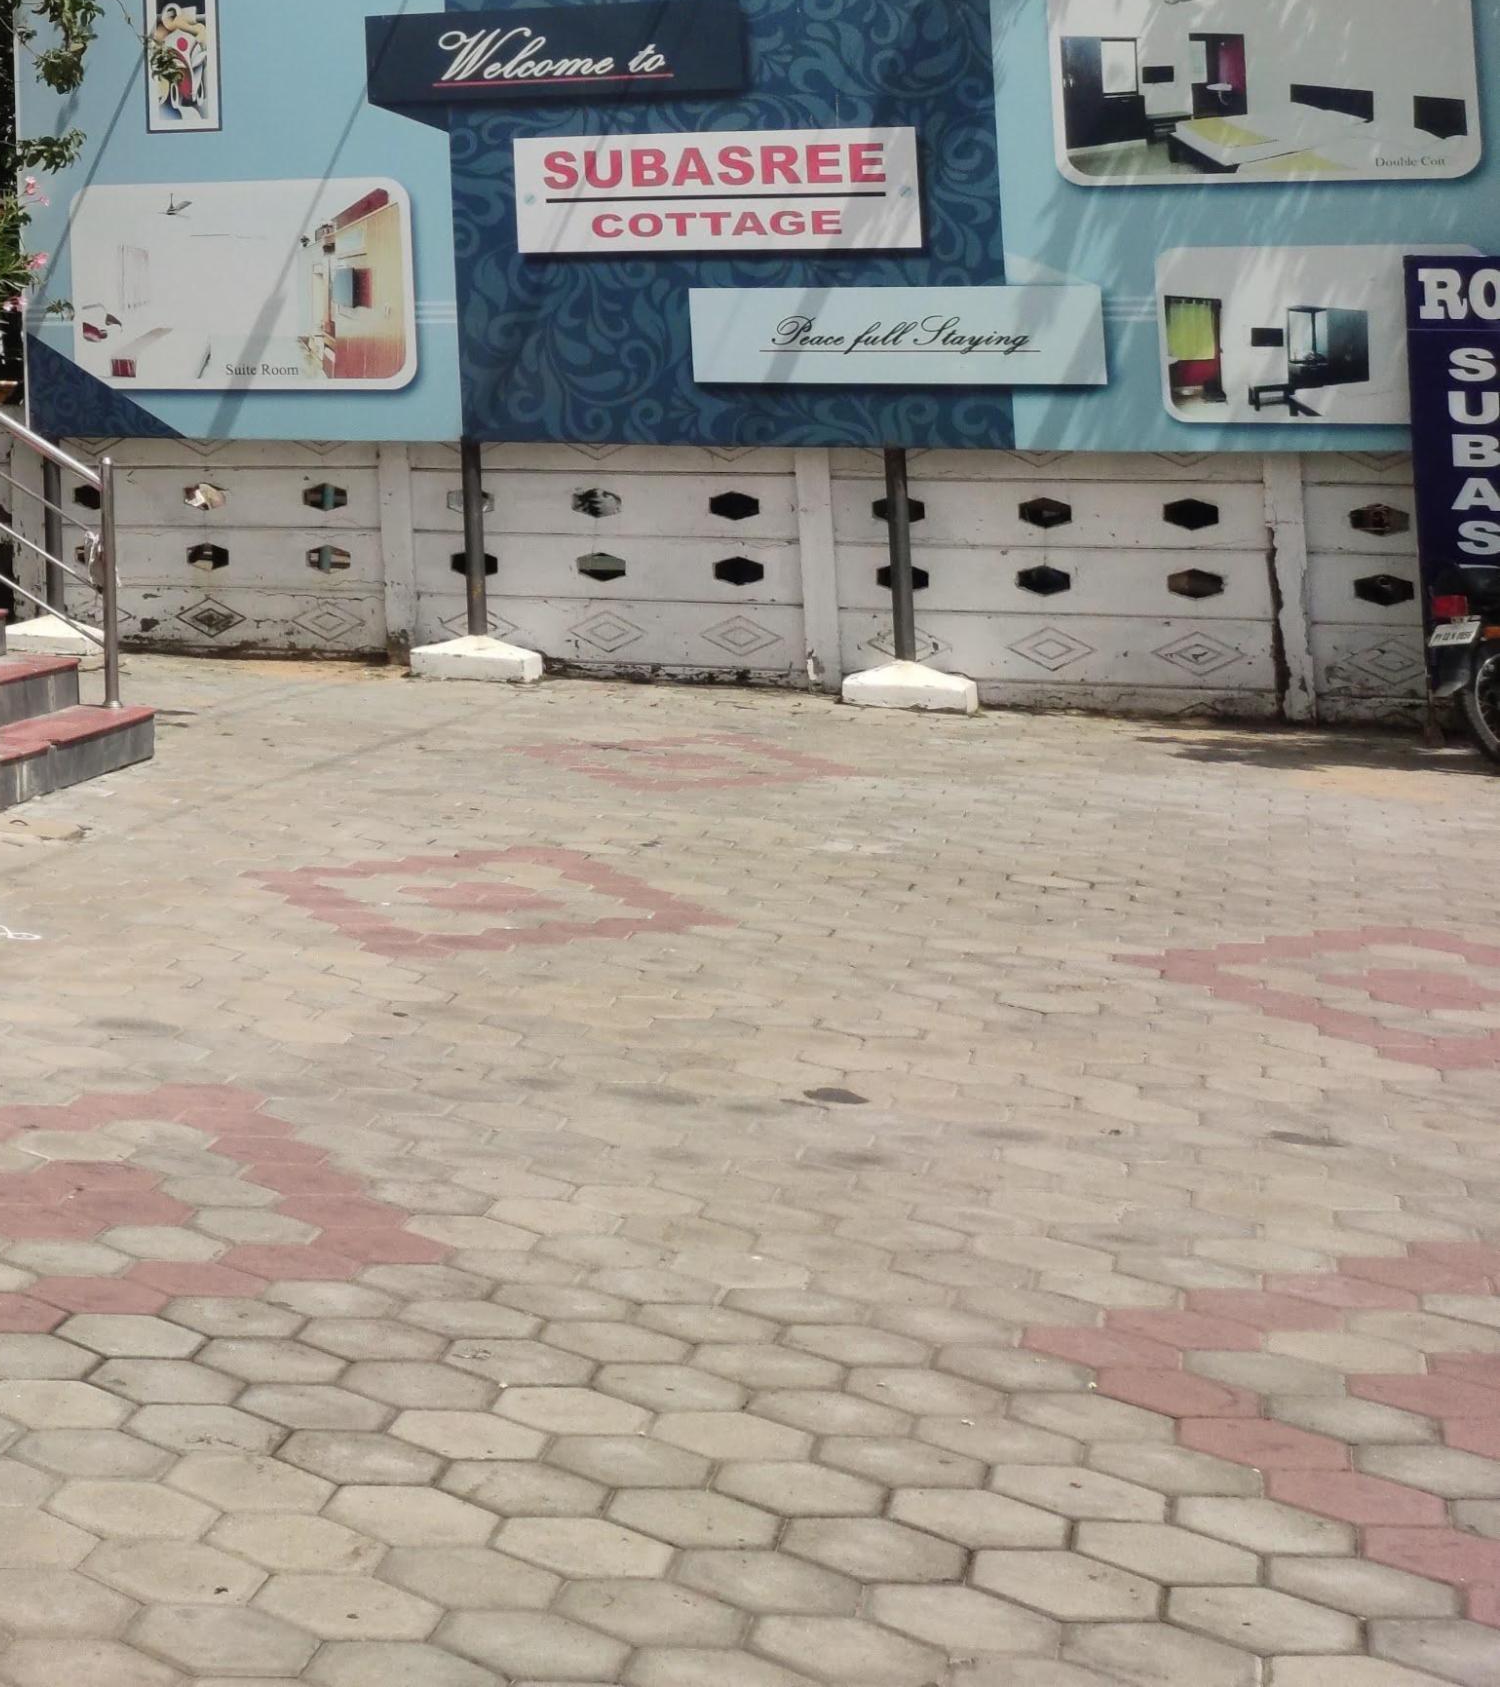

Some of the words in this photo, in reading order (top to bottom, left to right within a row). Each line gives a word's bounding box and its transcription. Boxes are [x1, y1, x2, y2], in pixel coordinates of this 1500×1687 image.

[437, 26, 615, 81] Welcome
[627, 43, 666, 73] to
[543, 143, 886, 190] SUBASREE
[1375, 156, 1417, 167] Double
[591, 210, 842, 238] COTTAGE
[771, 315, 845, 345] Peace
[843, 321, 918, 354] full
[912, 315, 1030, 355] Staying
[225, 363, 257, 376] Suite
[261, 363, 299, 376] Room
